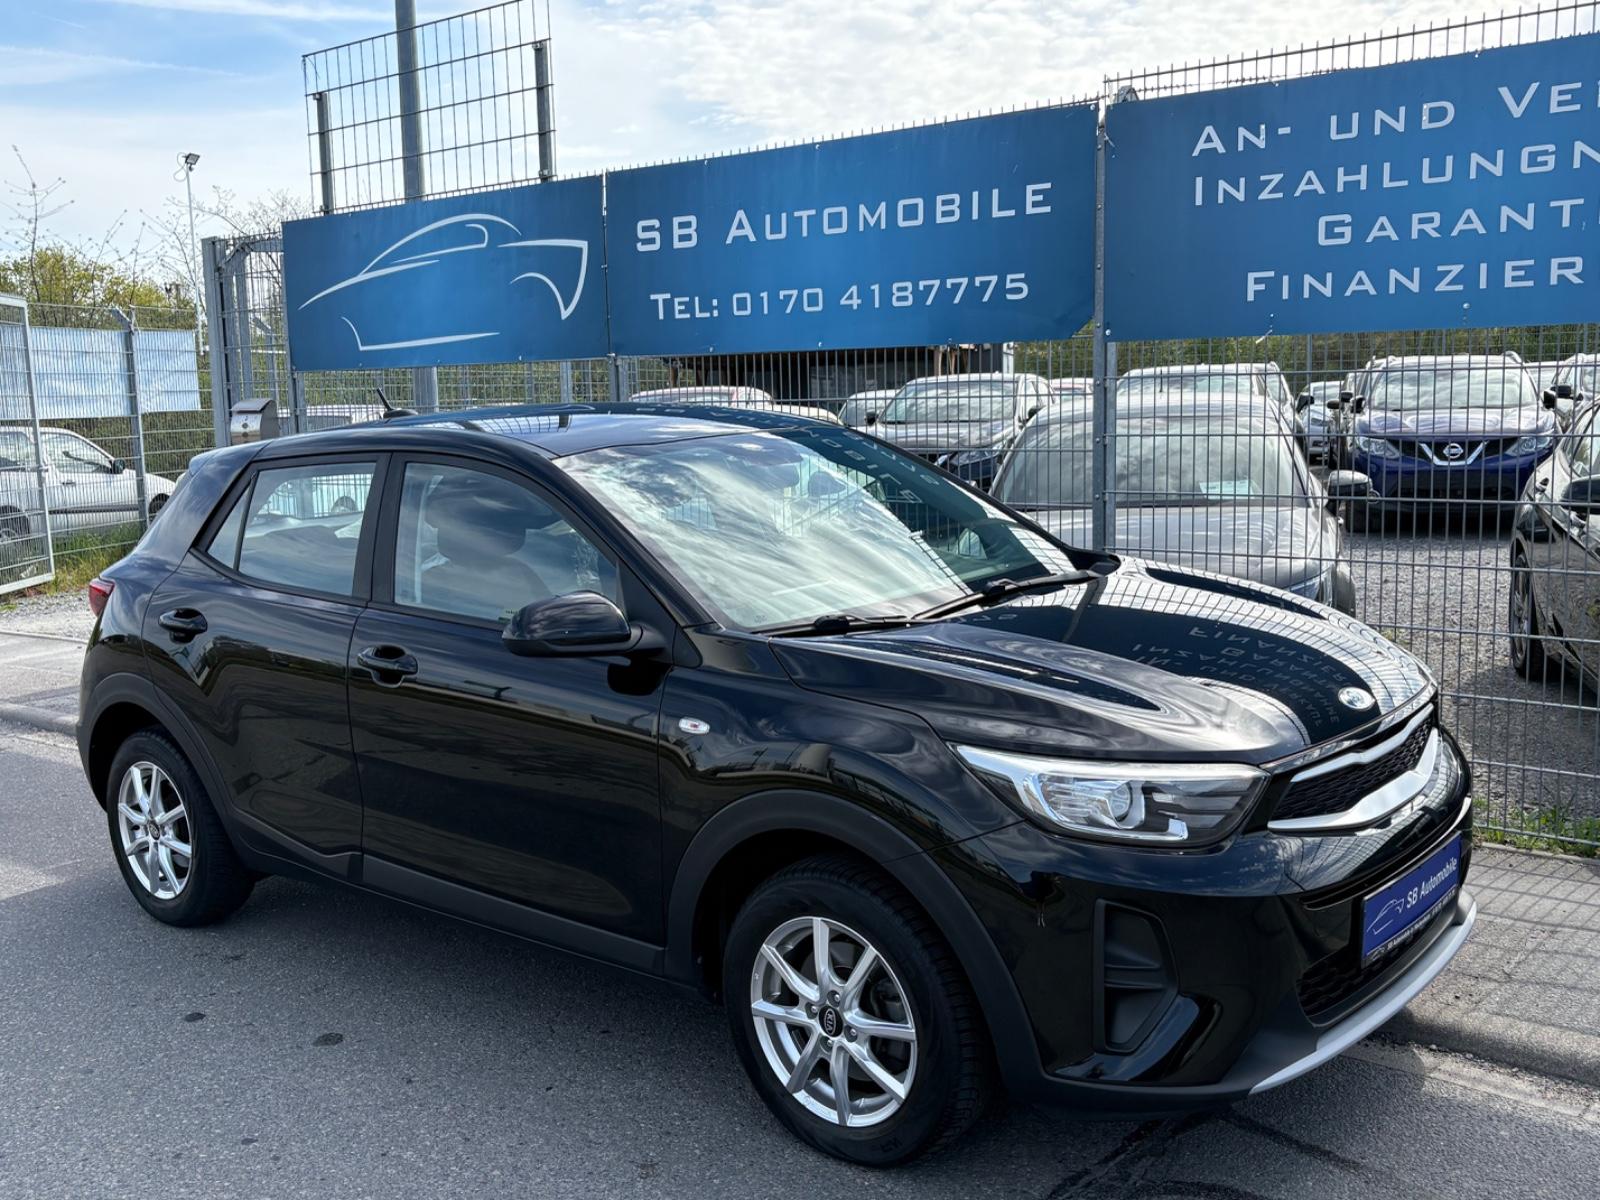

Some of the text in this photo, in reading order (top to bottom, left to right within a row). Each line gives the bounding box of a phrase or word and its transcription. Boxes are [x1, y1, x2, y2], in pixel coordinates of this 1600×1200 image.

[1331, 101, 1455, 140] UND
[1499, 82, 1600, 117] VE
[1195, 140, 1600, 205] INZAHLUNGN
[636, 214, 698, 252] SB
[1318, 198, 1600, 246] GARANT
[732, 287, 823, 316] 0170
[839, 273, 1029, 310] 4187775
[1247, 256, 1584, 301] FINANZIER
[1406, 887, 1418, 909] SB
[1420, 857, 1457, 899] Automobile
